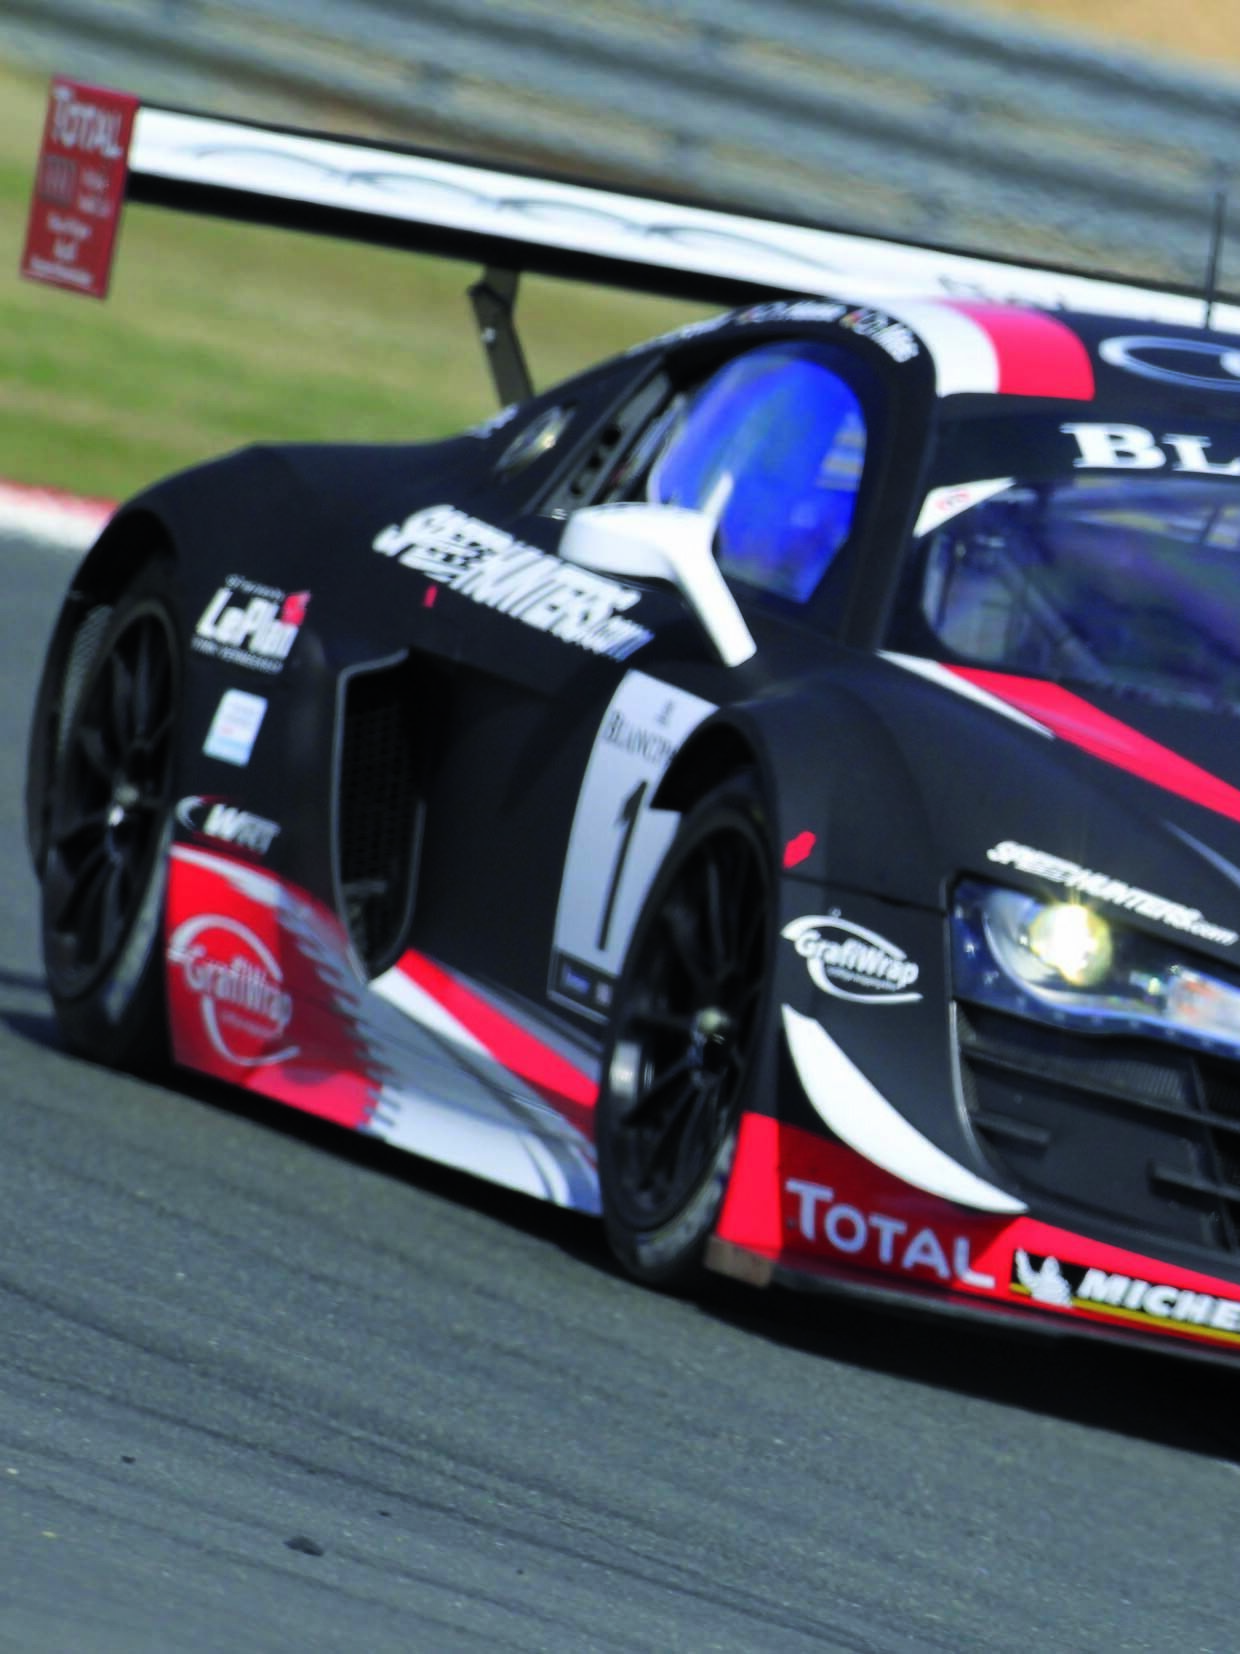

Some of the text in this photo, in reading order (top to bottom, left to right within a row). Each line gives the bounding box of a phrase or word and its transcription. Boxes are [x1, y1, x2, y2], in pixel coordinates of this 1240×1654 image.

[53, 86, 123, 159] TOTAL
[596, 779, 649, 952] 1
[786, 1178, 996, 1289] TOTAL
